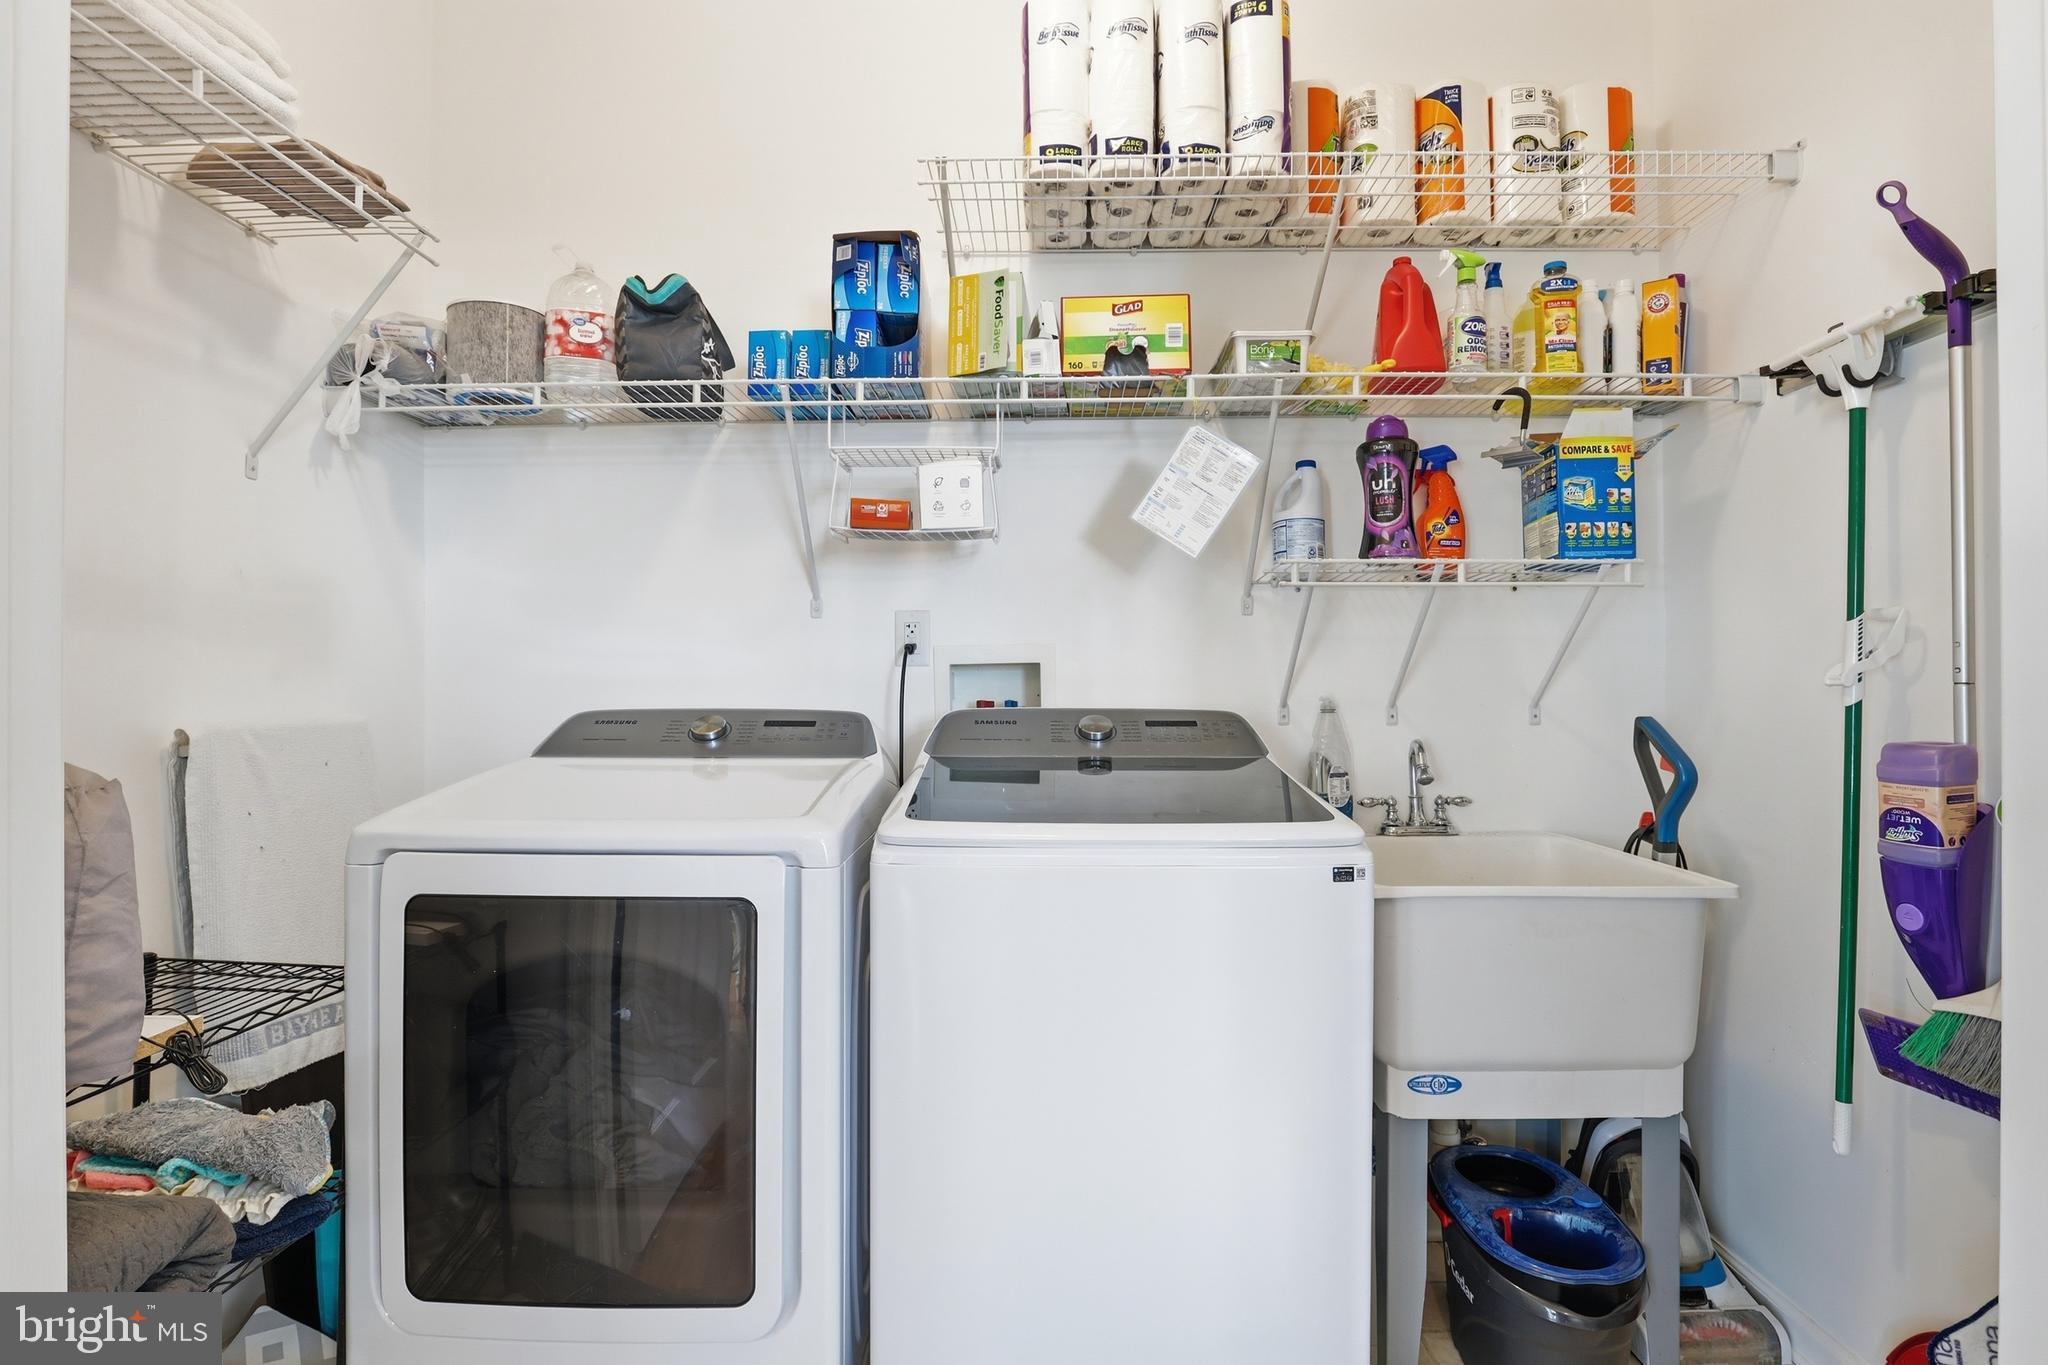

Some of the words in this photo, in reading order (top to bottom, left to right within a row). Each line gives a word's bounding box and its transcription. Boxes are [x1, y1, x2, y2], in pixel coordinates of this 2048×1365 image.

[1184, 27, 1218, 39] athTissue
[853, 262, 869, 295] Ziploc
[896, 264, 912, 299] Ziploc
[1550, 279, 1564, 287] 2X
[1114, 302, 1142, 315] GLAD
[992, 288, 1005, 355] FoodSaver
[854, 331, 870, 348] Zip
[1467, 337, 1487, 346] ODO
[1250, 342, 1276, 355] Bona
[753, 345, 767, 377] Ziploc
[796, 345, 810, 377] Ziploc
[1069, 361, 1083, 370] 160
[1562, 445, 1603, 455] COMPARE
[1603, 445, 1610, 454] &
[1611, 444, 1632, 454] SAVE
[1375, 495, 1395, 506] LUSH
[1886, 812, 1922, 825] WETJET
[1885, 826, 1924, 843] Swiffer
